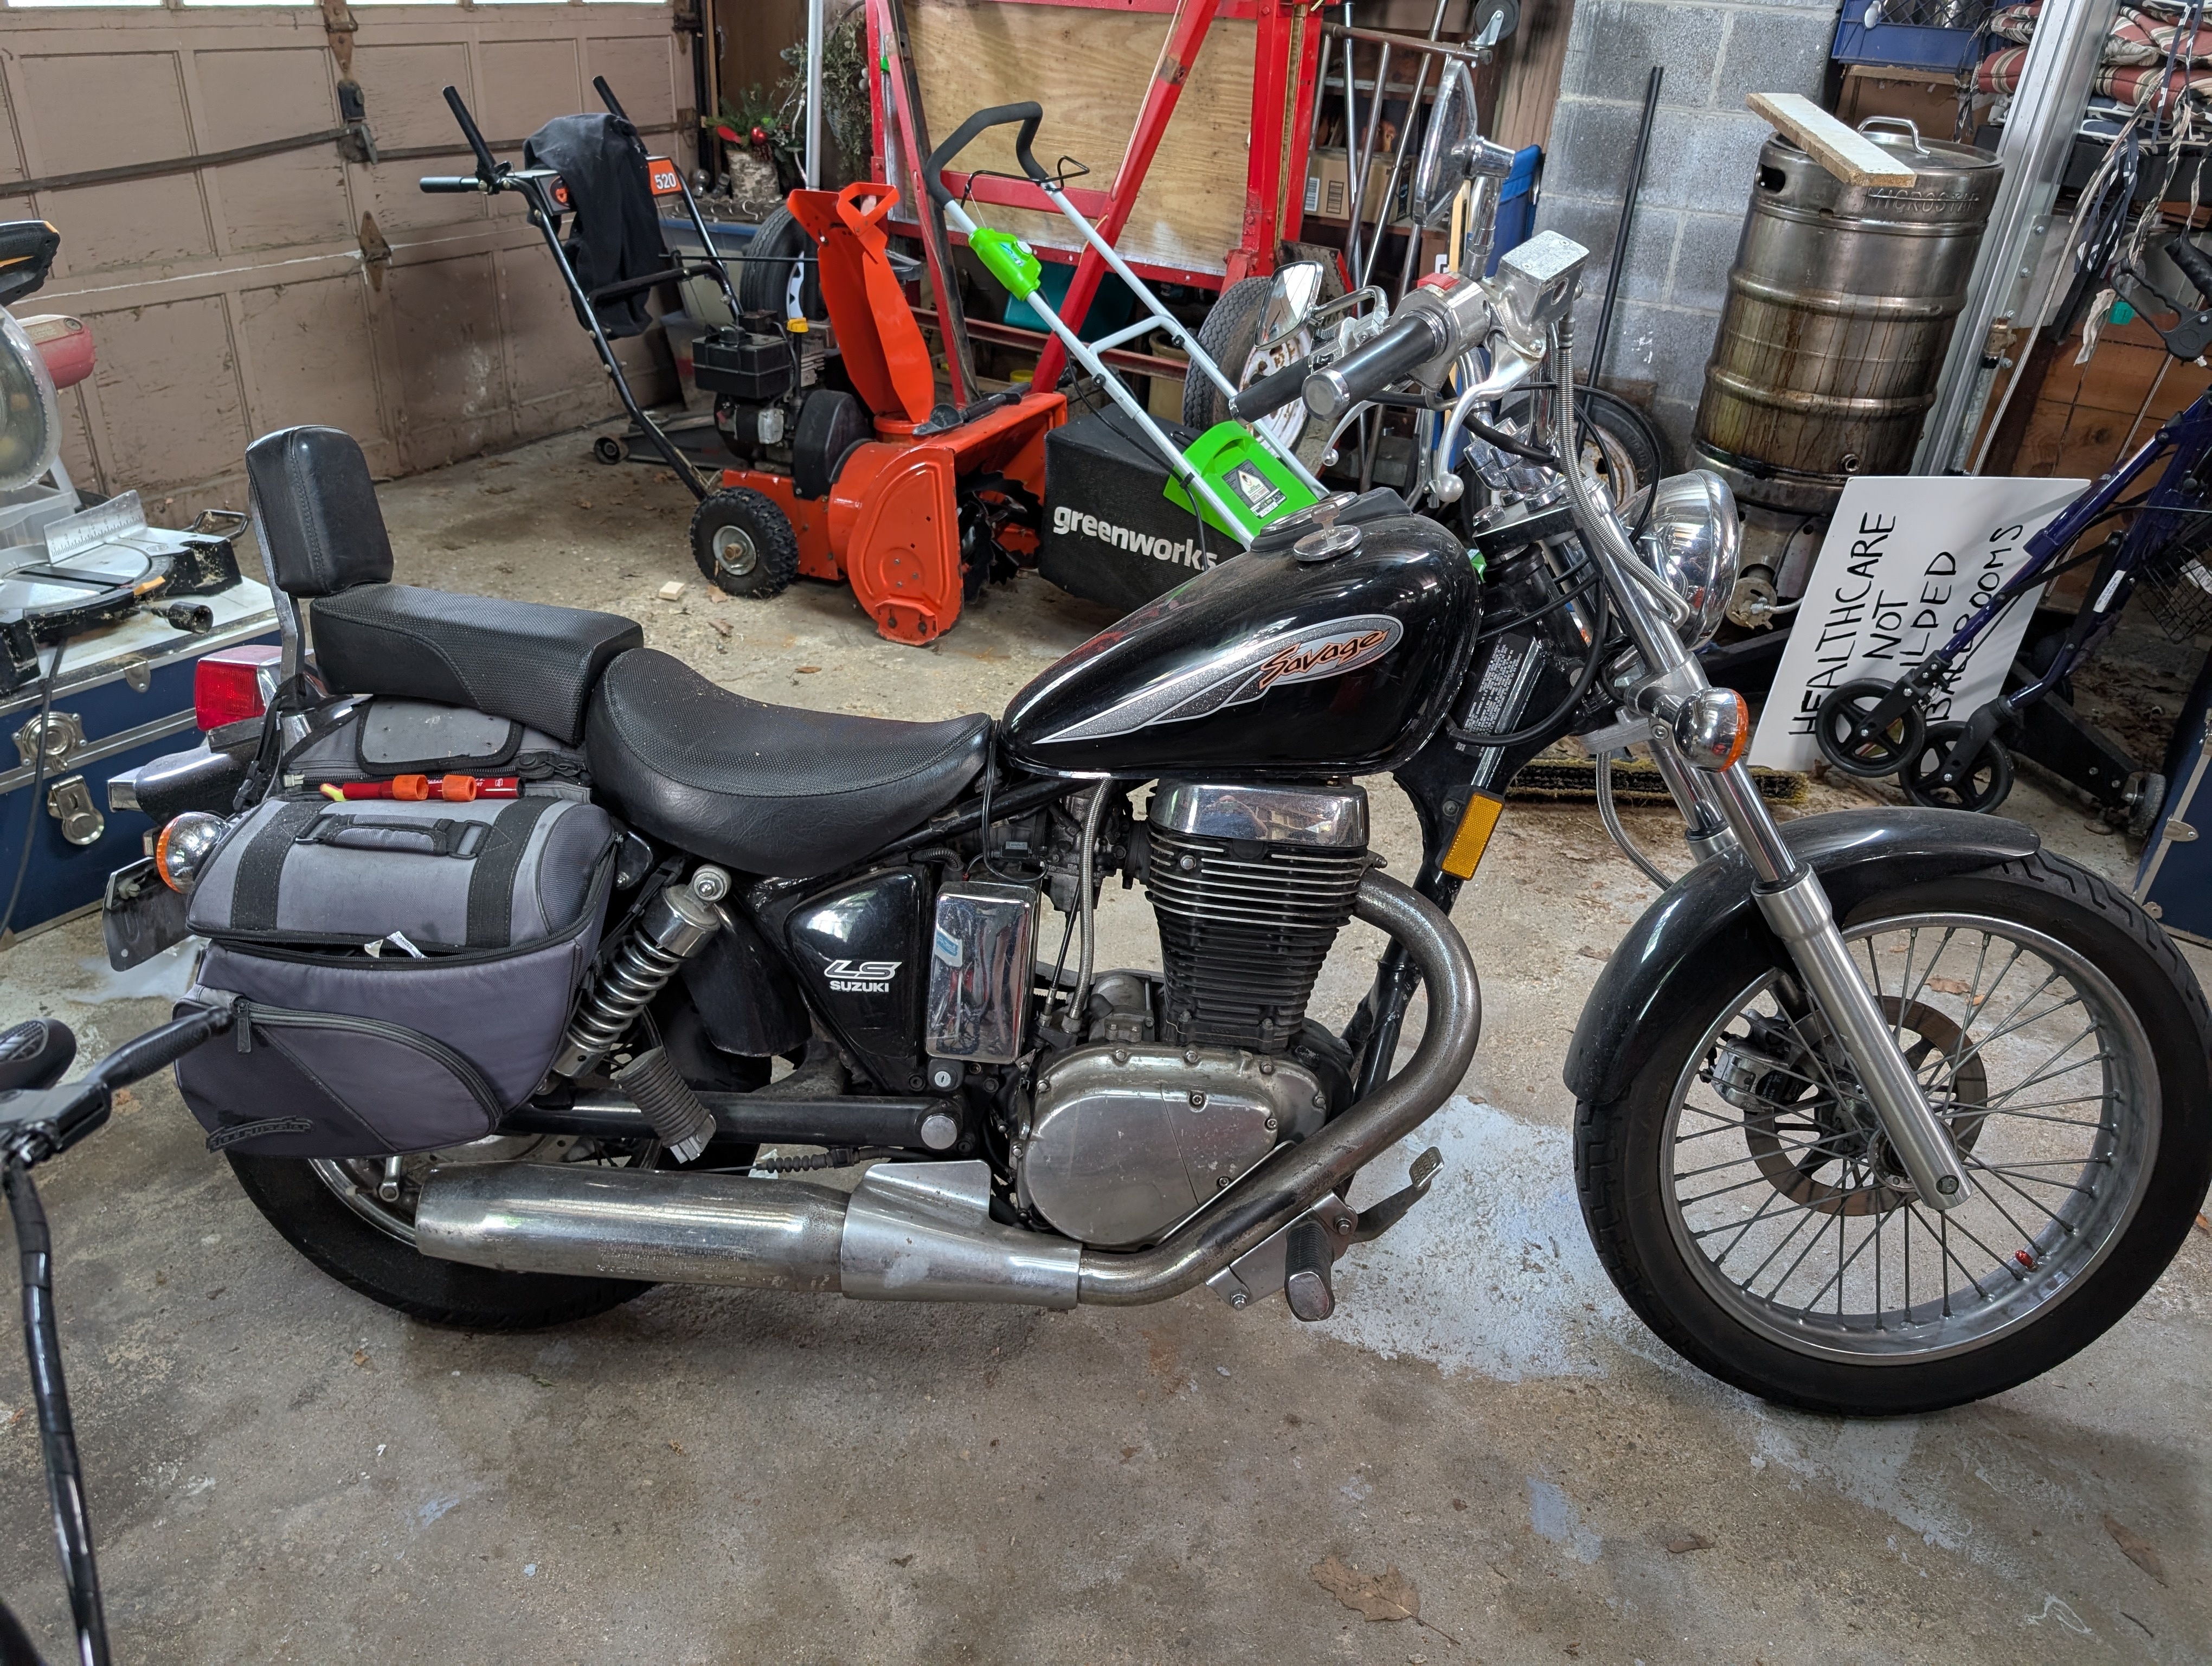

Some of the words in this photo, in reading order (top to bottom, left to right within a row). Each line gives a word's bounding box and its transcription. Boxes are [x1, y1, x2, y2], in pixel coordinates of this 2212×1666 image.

[654, 172, 677, 189] 520
[1053, 506, 1218, 571] greenworks
[1788, 512, 1896, 735] HEALTHCARE
[1862, 589, 1908, 659] NOT
[1899, 551, 1957, 667] ILDED
[1259, 626, 1392, 690] Savage
[824, 959, 903, 981] LS
[829, 981, 889, 992] SUZUKI
